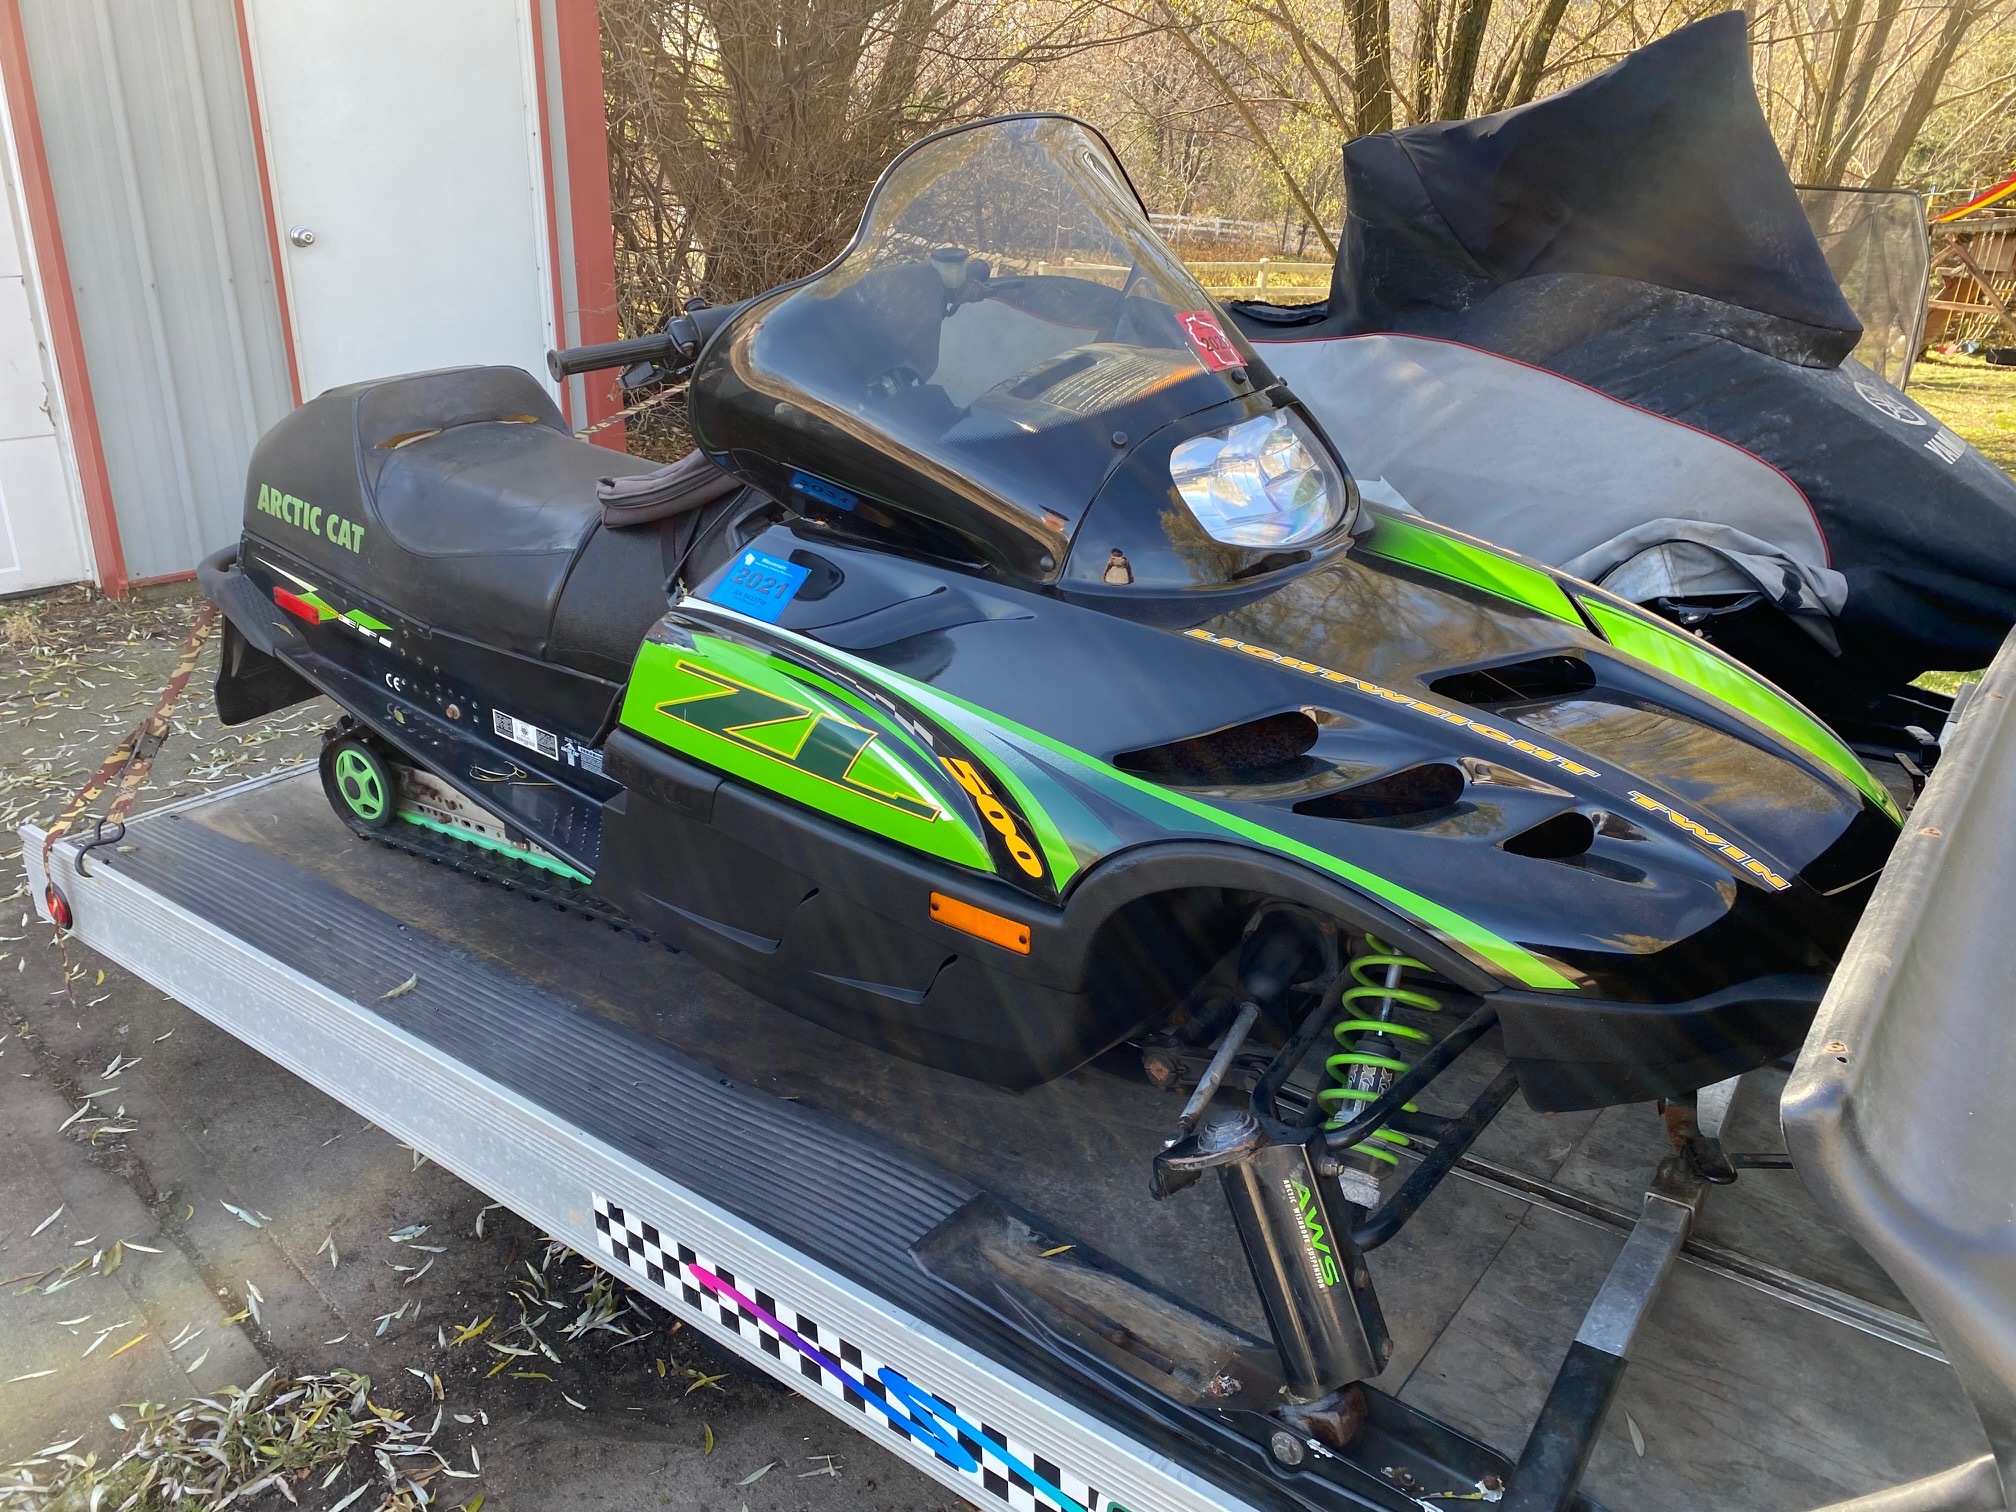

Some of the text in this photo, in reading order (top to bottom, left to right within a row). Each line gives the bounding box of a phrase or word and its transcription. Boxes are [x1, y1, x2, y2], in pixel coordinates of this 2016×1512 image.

[257, 482, 365, 554] ARCTIC CAT
[730, 567, 790, 600] 2021
[385, 673, 401, 692] CE
[1184, 628, 1601, 778] LIGHTWEIGHT
[937, 756, 1044, 878] 500
[1628, 789, 1792, 891] TWIN
[1282, 1179, 1326, 1289] ARCTIC WISHBONE SUSPENSION
[1290, 1180, 1340, 1286] AWS
